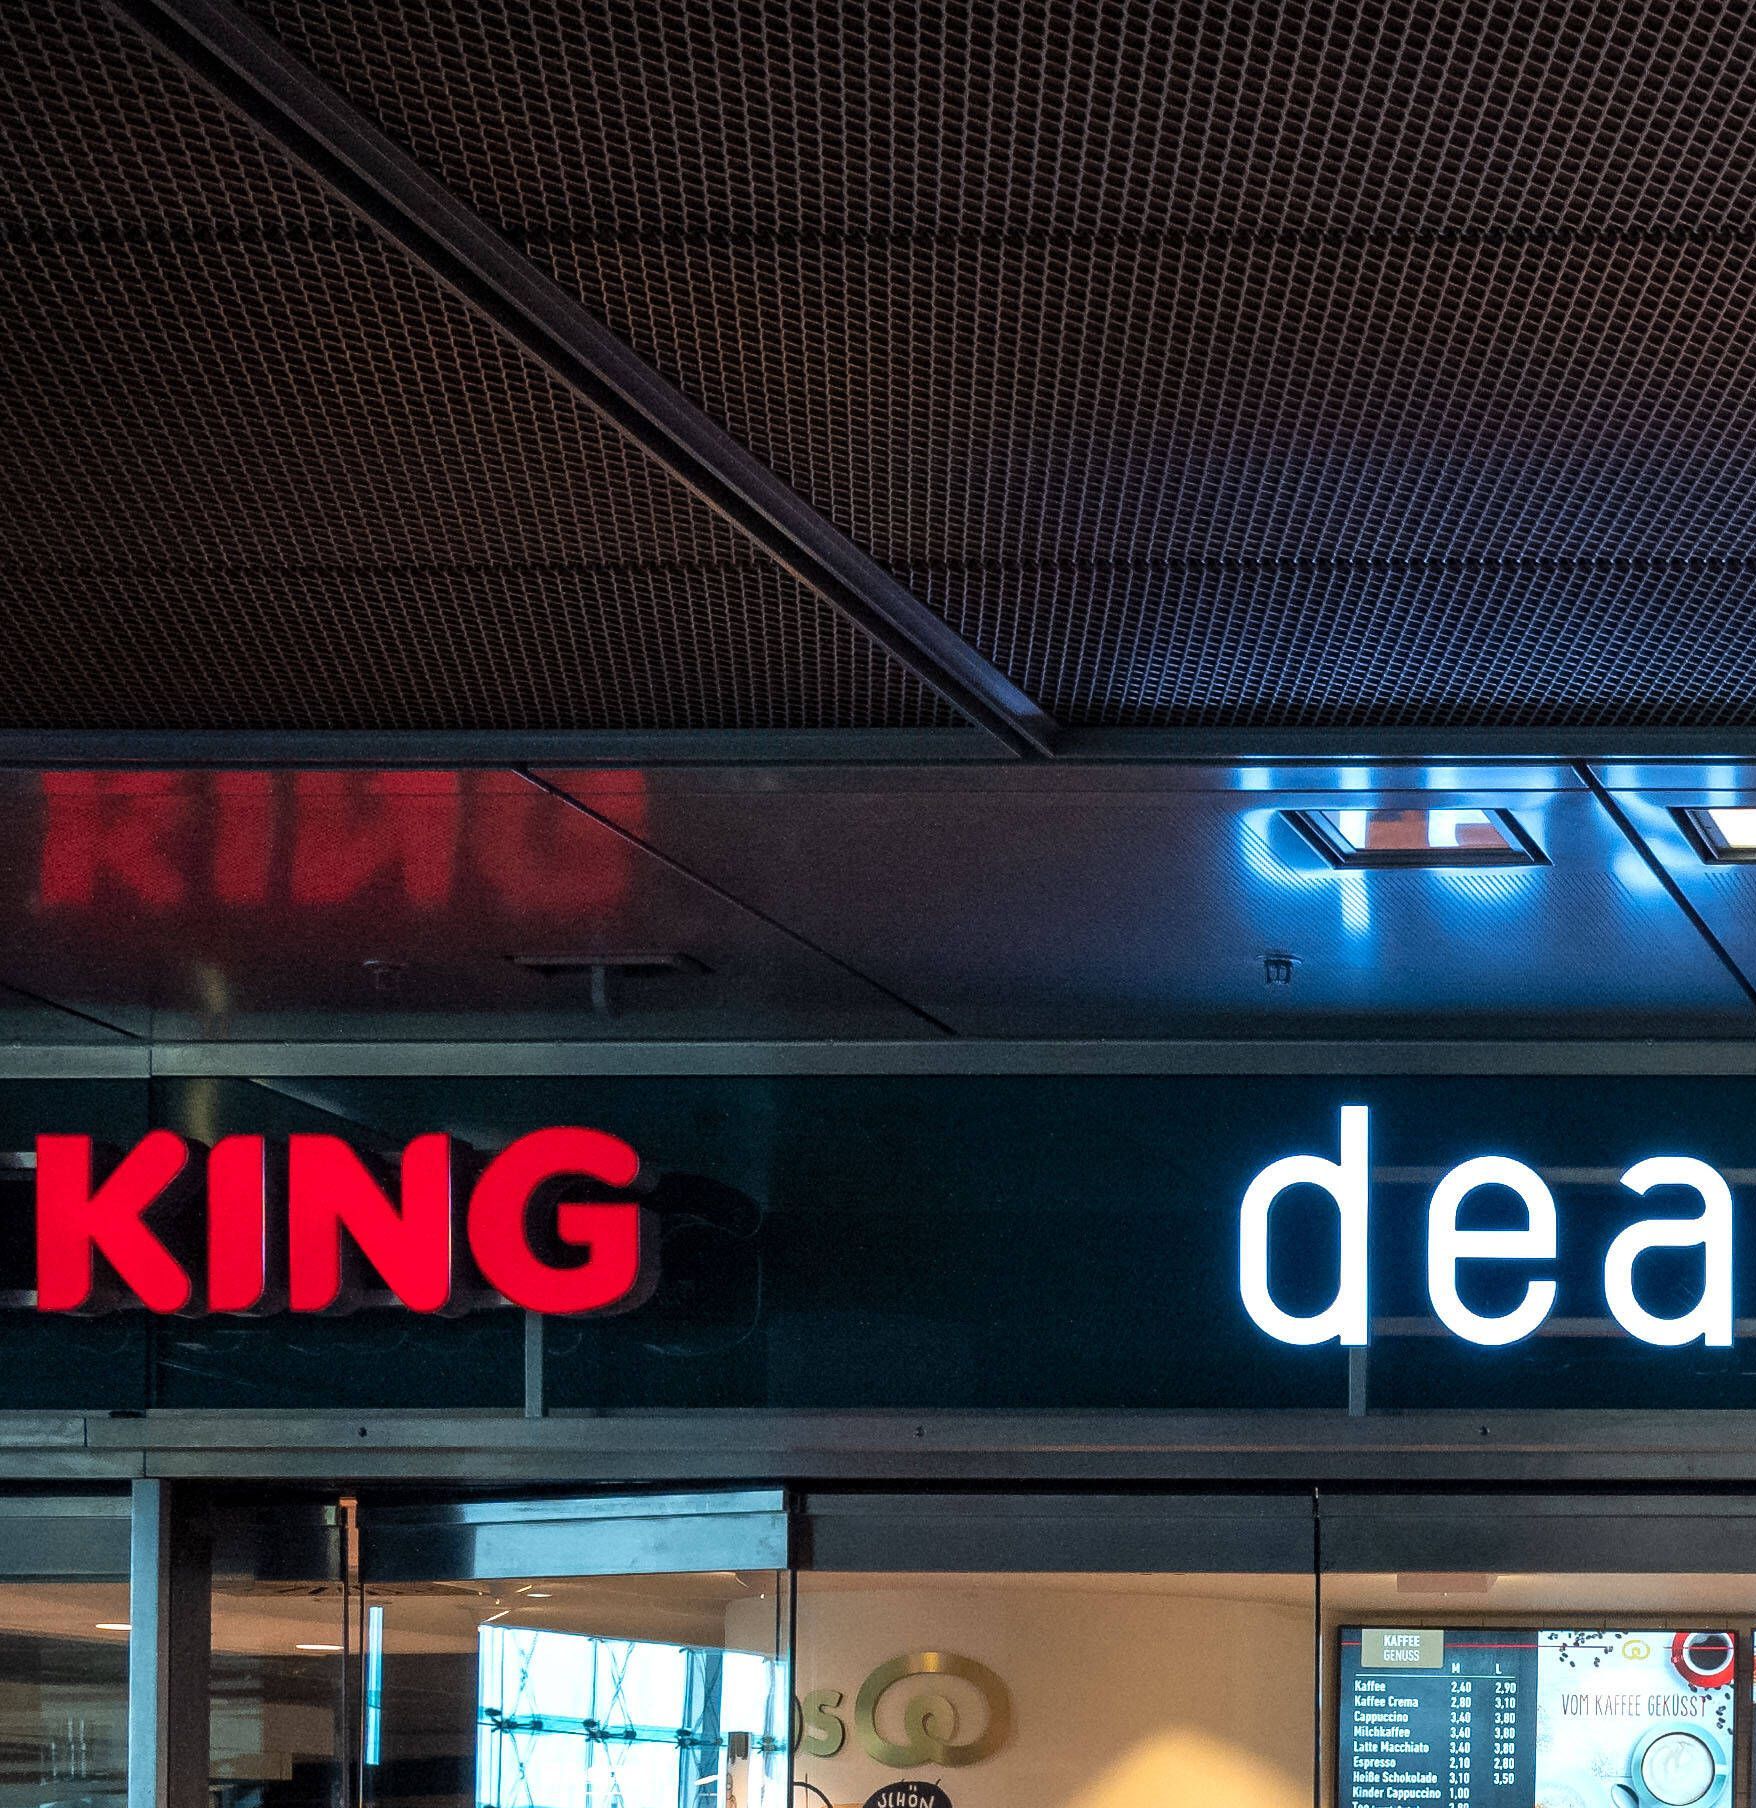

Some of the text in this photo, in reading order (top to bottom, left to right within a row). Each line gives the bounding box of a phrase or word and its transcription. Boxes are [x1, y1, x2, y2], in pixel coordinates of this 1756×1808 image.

[35, 1126, 642, 1316] KING
[1383, 1634, 1421, 1648] KAFFEE
[1383, 1649, 1421, 1663] GENUSS
[1451, 1662, 1502, 1675] M L
[1354, 1679, 1386, 1692] Kaffee
[1495, 1681, 1517, 1694] 2,90
[1354, 1695, 1386, 1708] Kaffee
[1388, 1696, 1419, 1708] Crema
[1494, 1696, 1516, 1710] 3,10
[1561, 1693, 1708, 1718] VOM KAFFEE GEKÜSST
[1353, 1711, 1409, 1725] Cappuccino
[1353, 1725, 1411, 1738] Milchkaffee
[1353, 1741, 1378, 1753] Latte
[1380, 1741, 1430, 1753] Macchiato
[1353, 1756, 1397, 1769] Espresso
[1449, 1757, 1471, 1770] 2,10
[1382, 1771, 1438, 1783] Schokolade
[1449, 1772, 1470, 1785] 3,10
[1493, 1772, 1515, 1785] 3,50
[1352, 1786, 1470, 1800] Kinder Cappuccino 1,00
